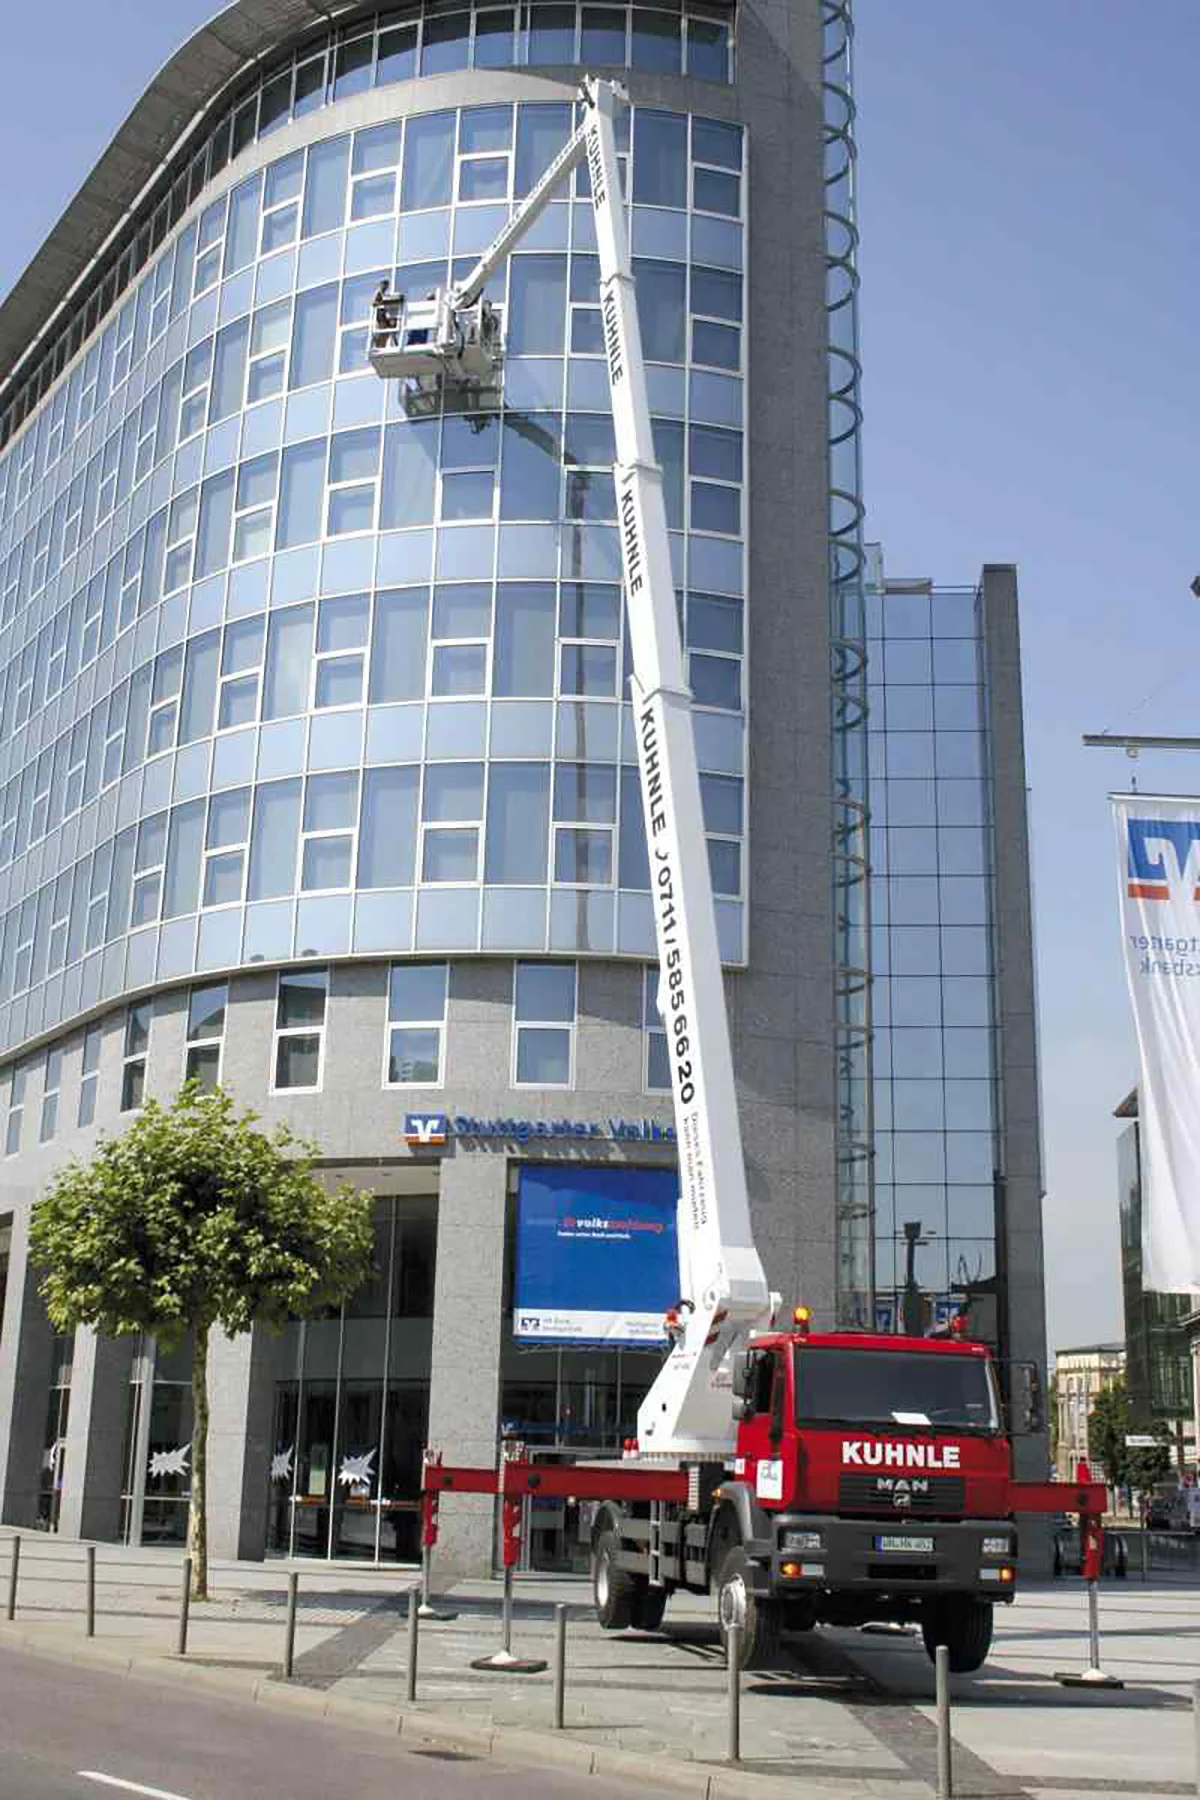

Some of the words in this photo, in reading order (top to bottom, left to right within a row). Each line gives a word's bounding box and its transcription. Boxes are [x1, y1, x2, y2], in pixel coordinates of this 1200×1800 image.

[588, 124, 606, 210] KUHNLE
[603, 290, 624, 387] KUHNLE
[620, 489, 643, 597] KUHNLE
[640, 706, 666, 837] KUHNLE
[842, 1441, 960, 1468] KUHNLE
[876, 1477, 928, 1491] MAN
